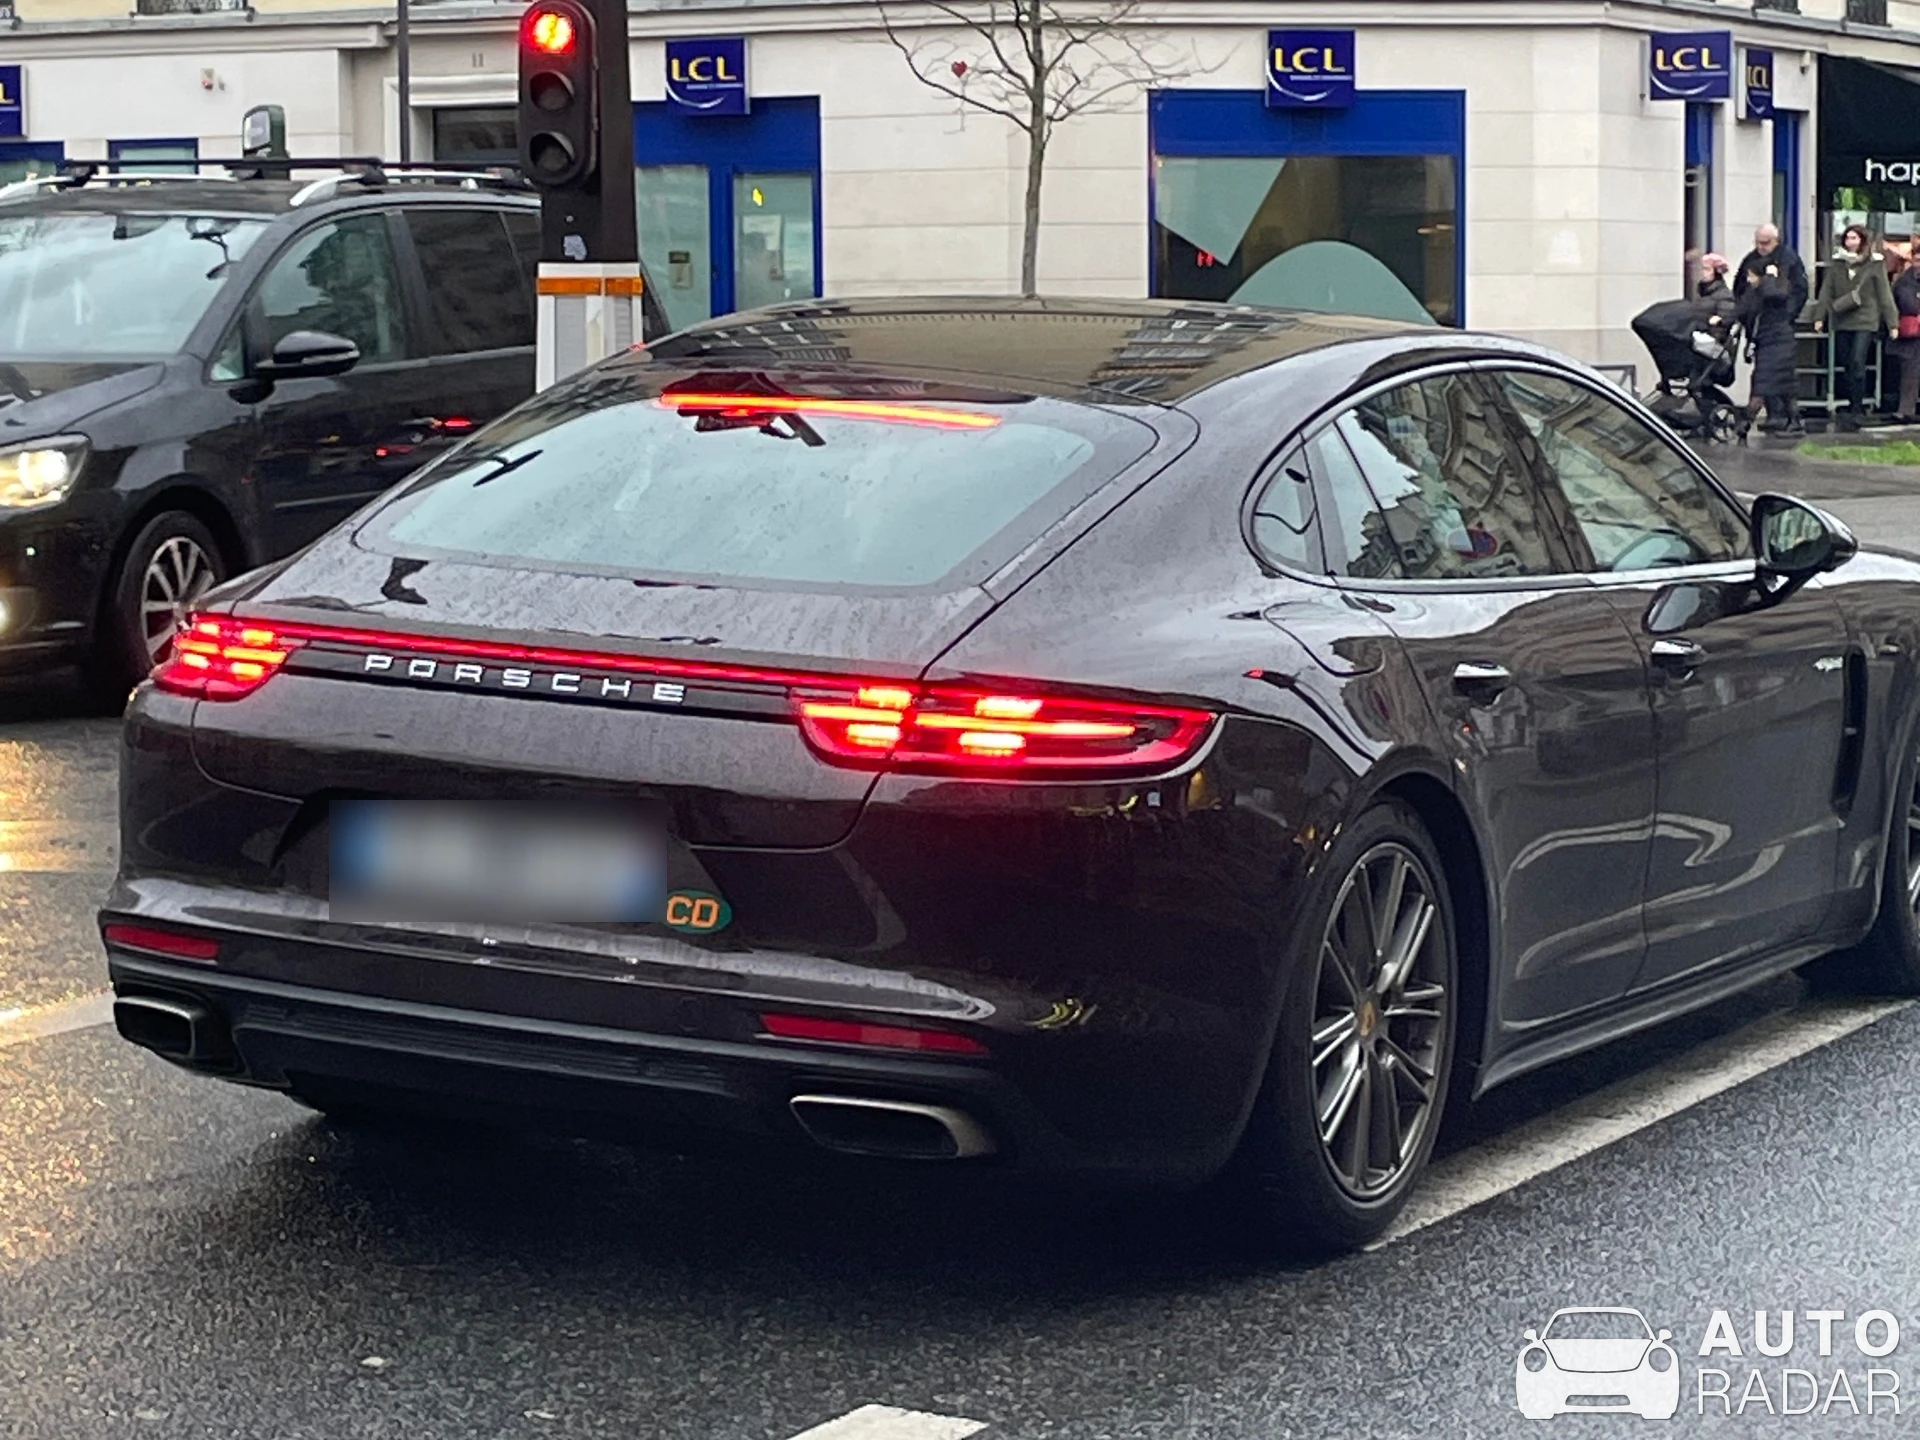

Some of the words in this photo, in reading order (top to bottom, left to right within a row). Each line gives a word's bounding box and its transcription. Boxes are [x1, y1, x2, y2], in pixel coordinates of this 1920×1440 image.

[671, 56, 737, 82] LCL
[1274, 47, 1346, 73] LCL
[1656, 47, 1721, 71] LCL
[1747, 65, 1768, 88] LCL
[364, 654, 686, 703] PORSCHE
[667, 895, 720, 929] CD
